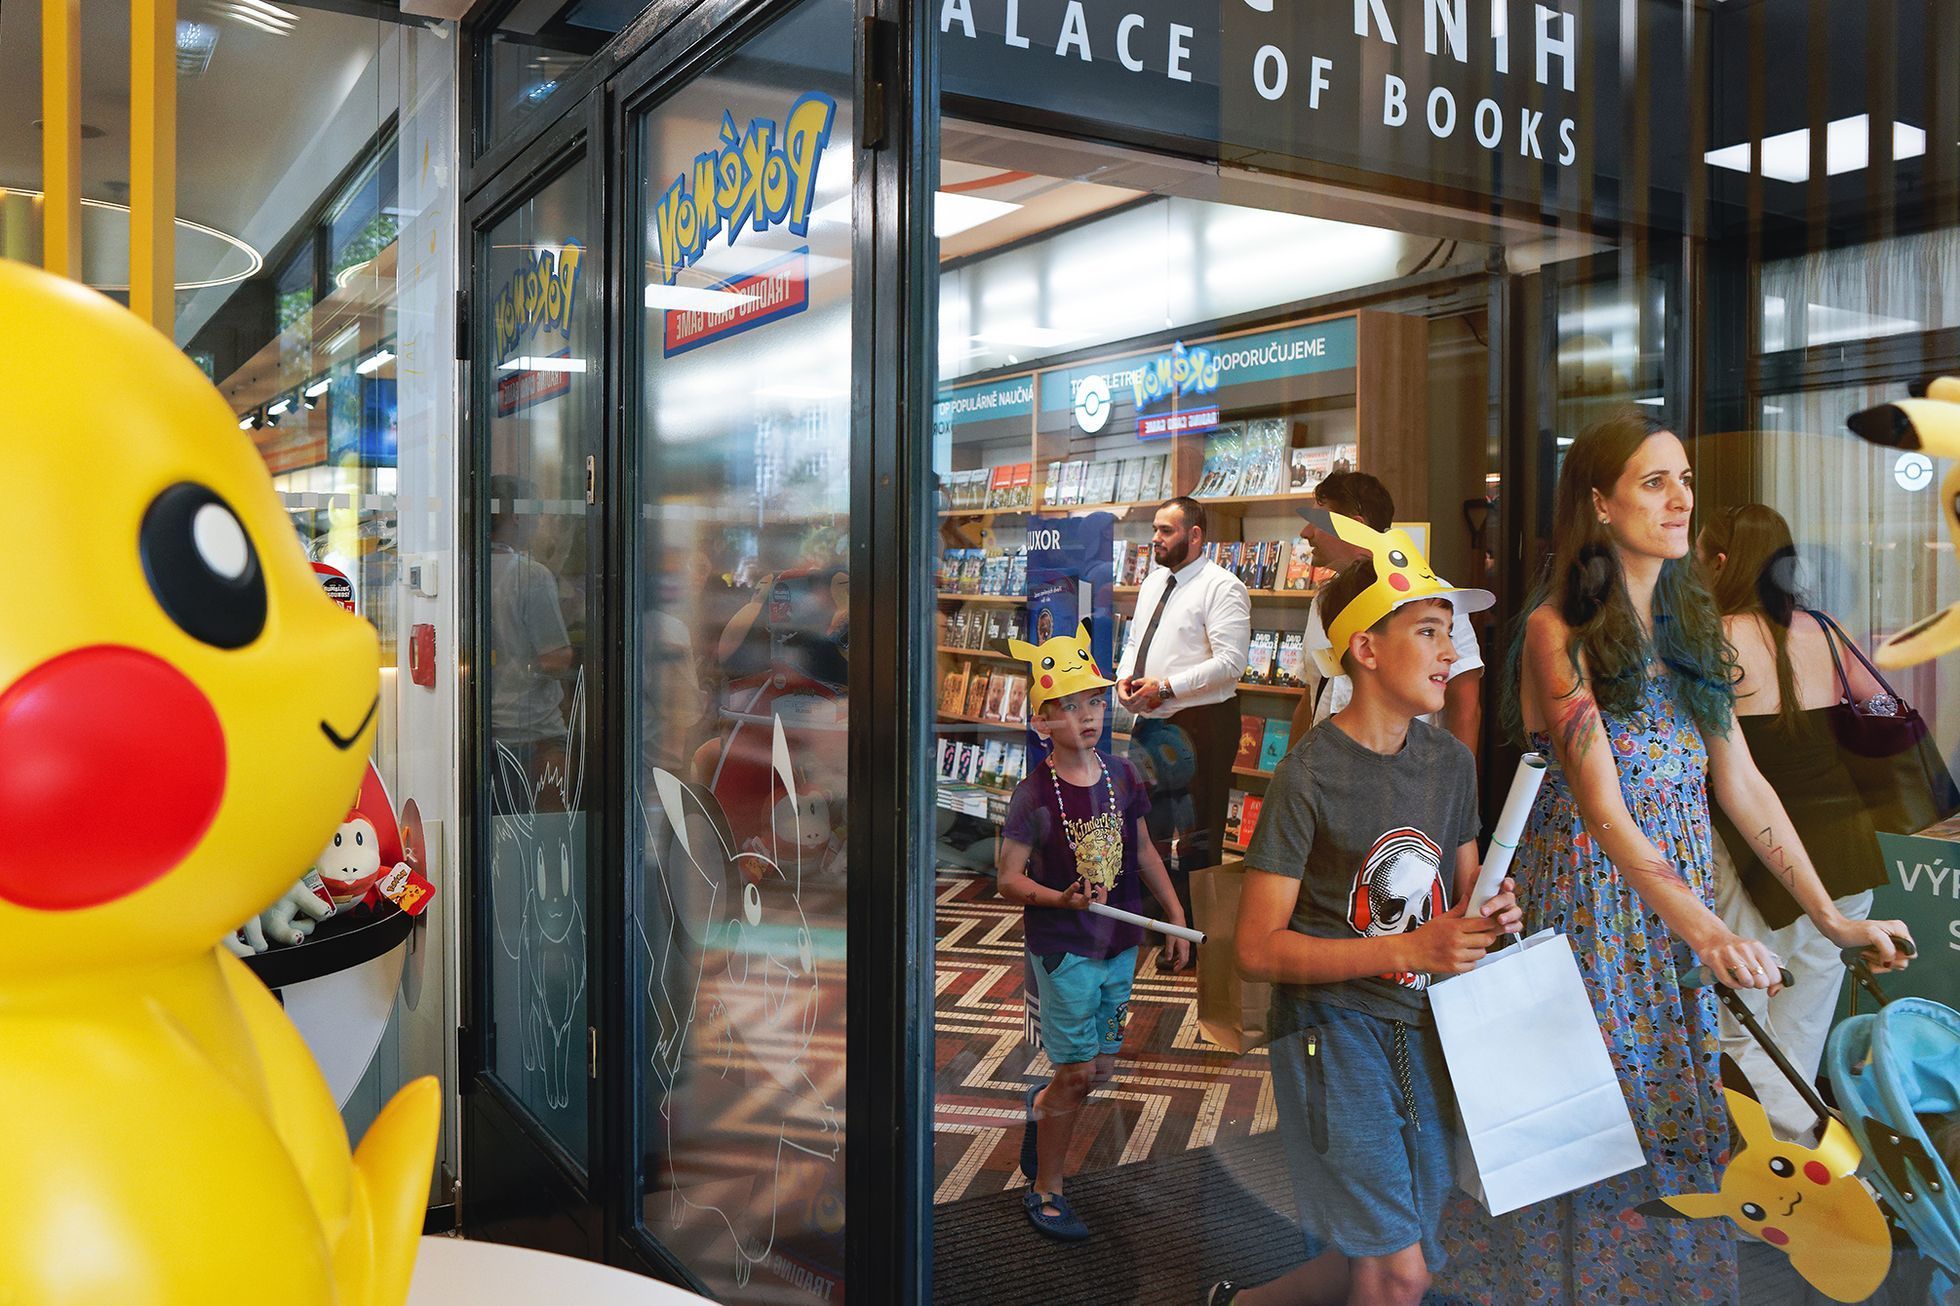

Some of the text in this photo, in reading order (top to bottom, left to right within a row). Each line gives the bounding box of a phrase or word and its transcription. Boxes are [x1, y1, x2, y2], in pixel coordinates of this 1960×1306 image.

[1253, 45, 1332, 109] OF
[1384, 74, 1576, 166] BOOKS
[1213, 338, 1326, 373] DOPORUČUJEME
[952, 391, 998, 414] POPULÁRNĚ
[998, 384, 1034, 406] NAUČNÁ
